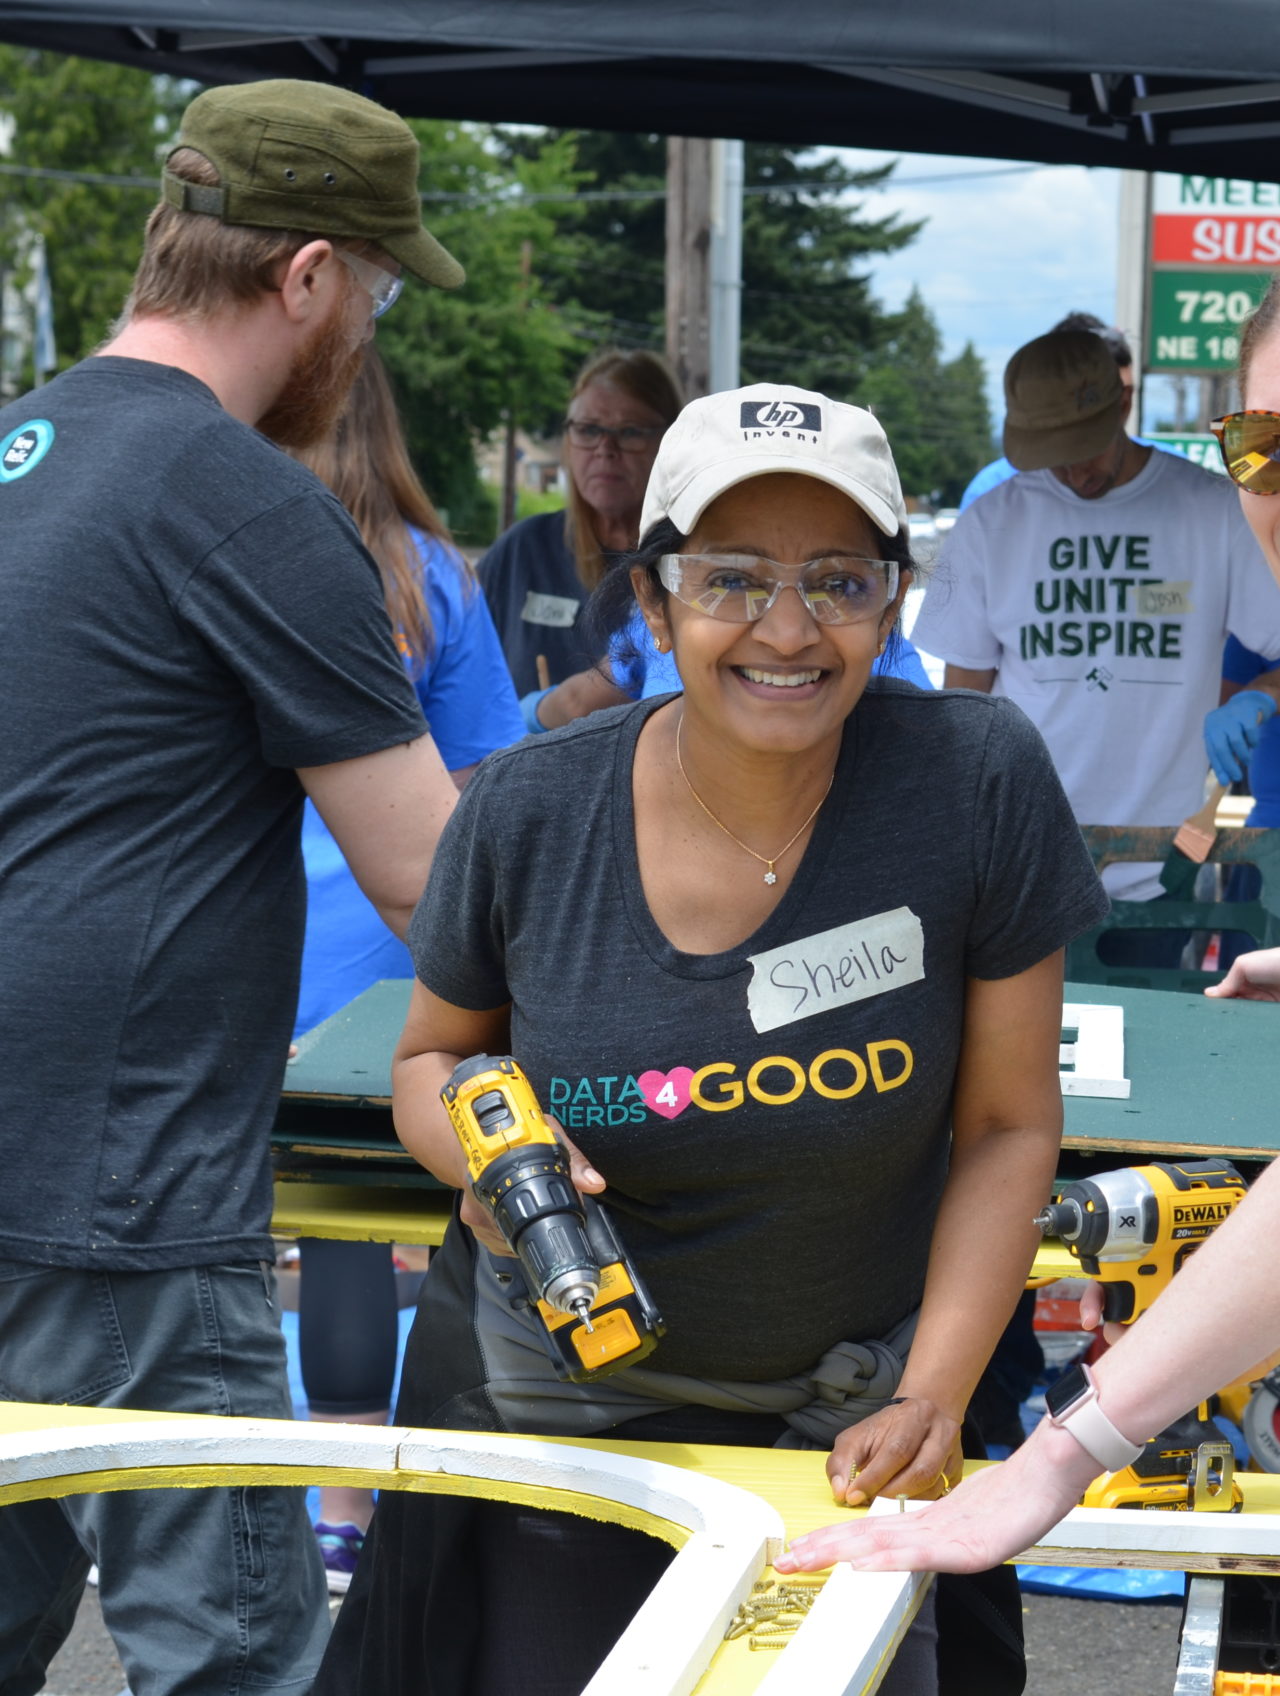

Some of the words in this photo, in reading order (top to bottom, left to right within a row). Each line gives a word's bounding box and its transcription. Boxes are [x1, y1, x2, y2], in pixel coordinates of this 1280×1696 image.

[1157, 336, 1197, 360] NE
[763, 402, 798, 427] hp
[12, 436, 35, 450] New
[1049, 535, 1150, 572] GIVE
[1035, 578, 1164, 614] UNIT
[1020, 621, 1182, 661] INSPIRE
[770, 941, 907, 1013] Sheila
[550, 1074, 647, 1105] DATA
[656, 1081, 678, 1107] 4
[689, 1039, 913, 1113] GOOD
[551, 1101, 648, 1128] NERDS
[1118, 1215, 1136, 1228] XR
